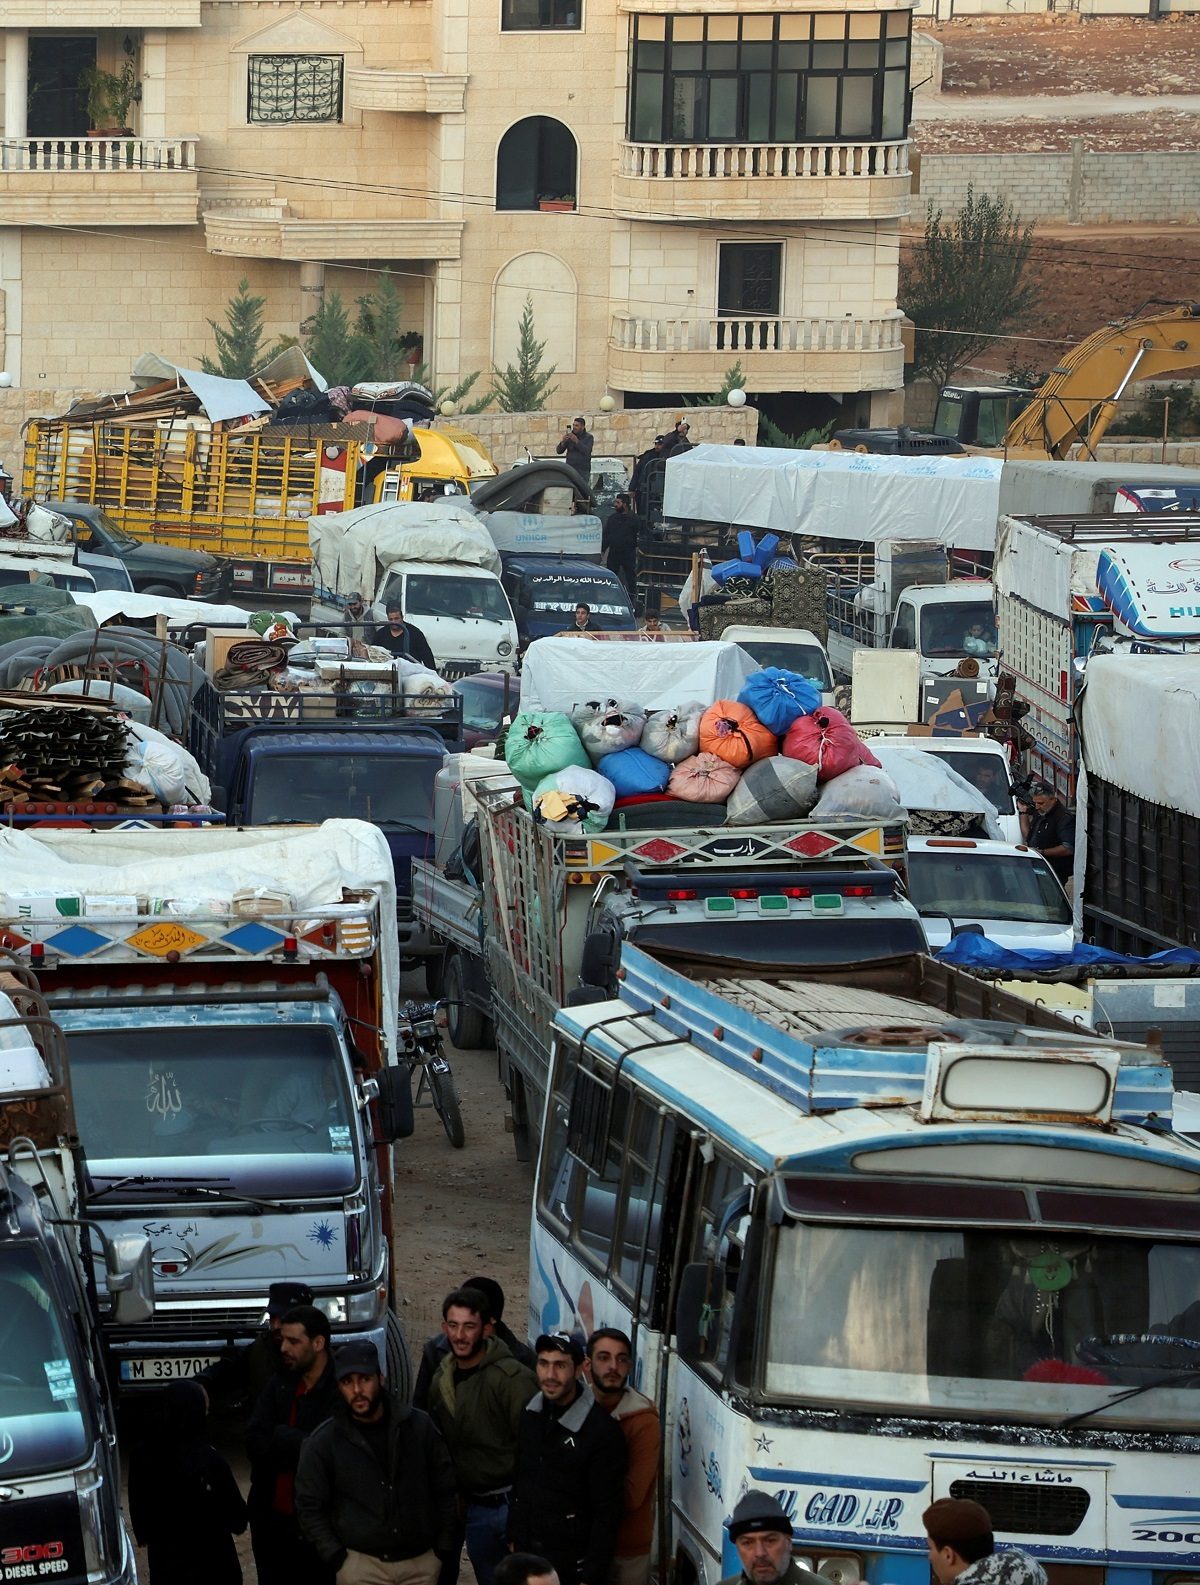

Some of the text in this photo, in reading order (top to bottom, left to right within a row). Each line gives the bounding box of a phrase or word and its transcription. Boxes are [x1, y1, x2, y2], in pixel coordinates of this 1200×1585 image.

[532, 575, 562, 583] الوالدين
[580, 576, 592, 584] الله
[534, 601, 623, 616] HYUDAI
[144, 1072, 182, 1121] الله
[132, 1361, 145, 1378] M
[965, 1466, 1016, 1481] الله
[1, 1541, 64, 1564] 300
[5, 1564, 38, 1580] DIESEL
[39, 1558, 69, 1575] SPEED
